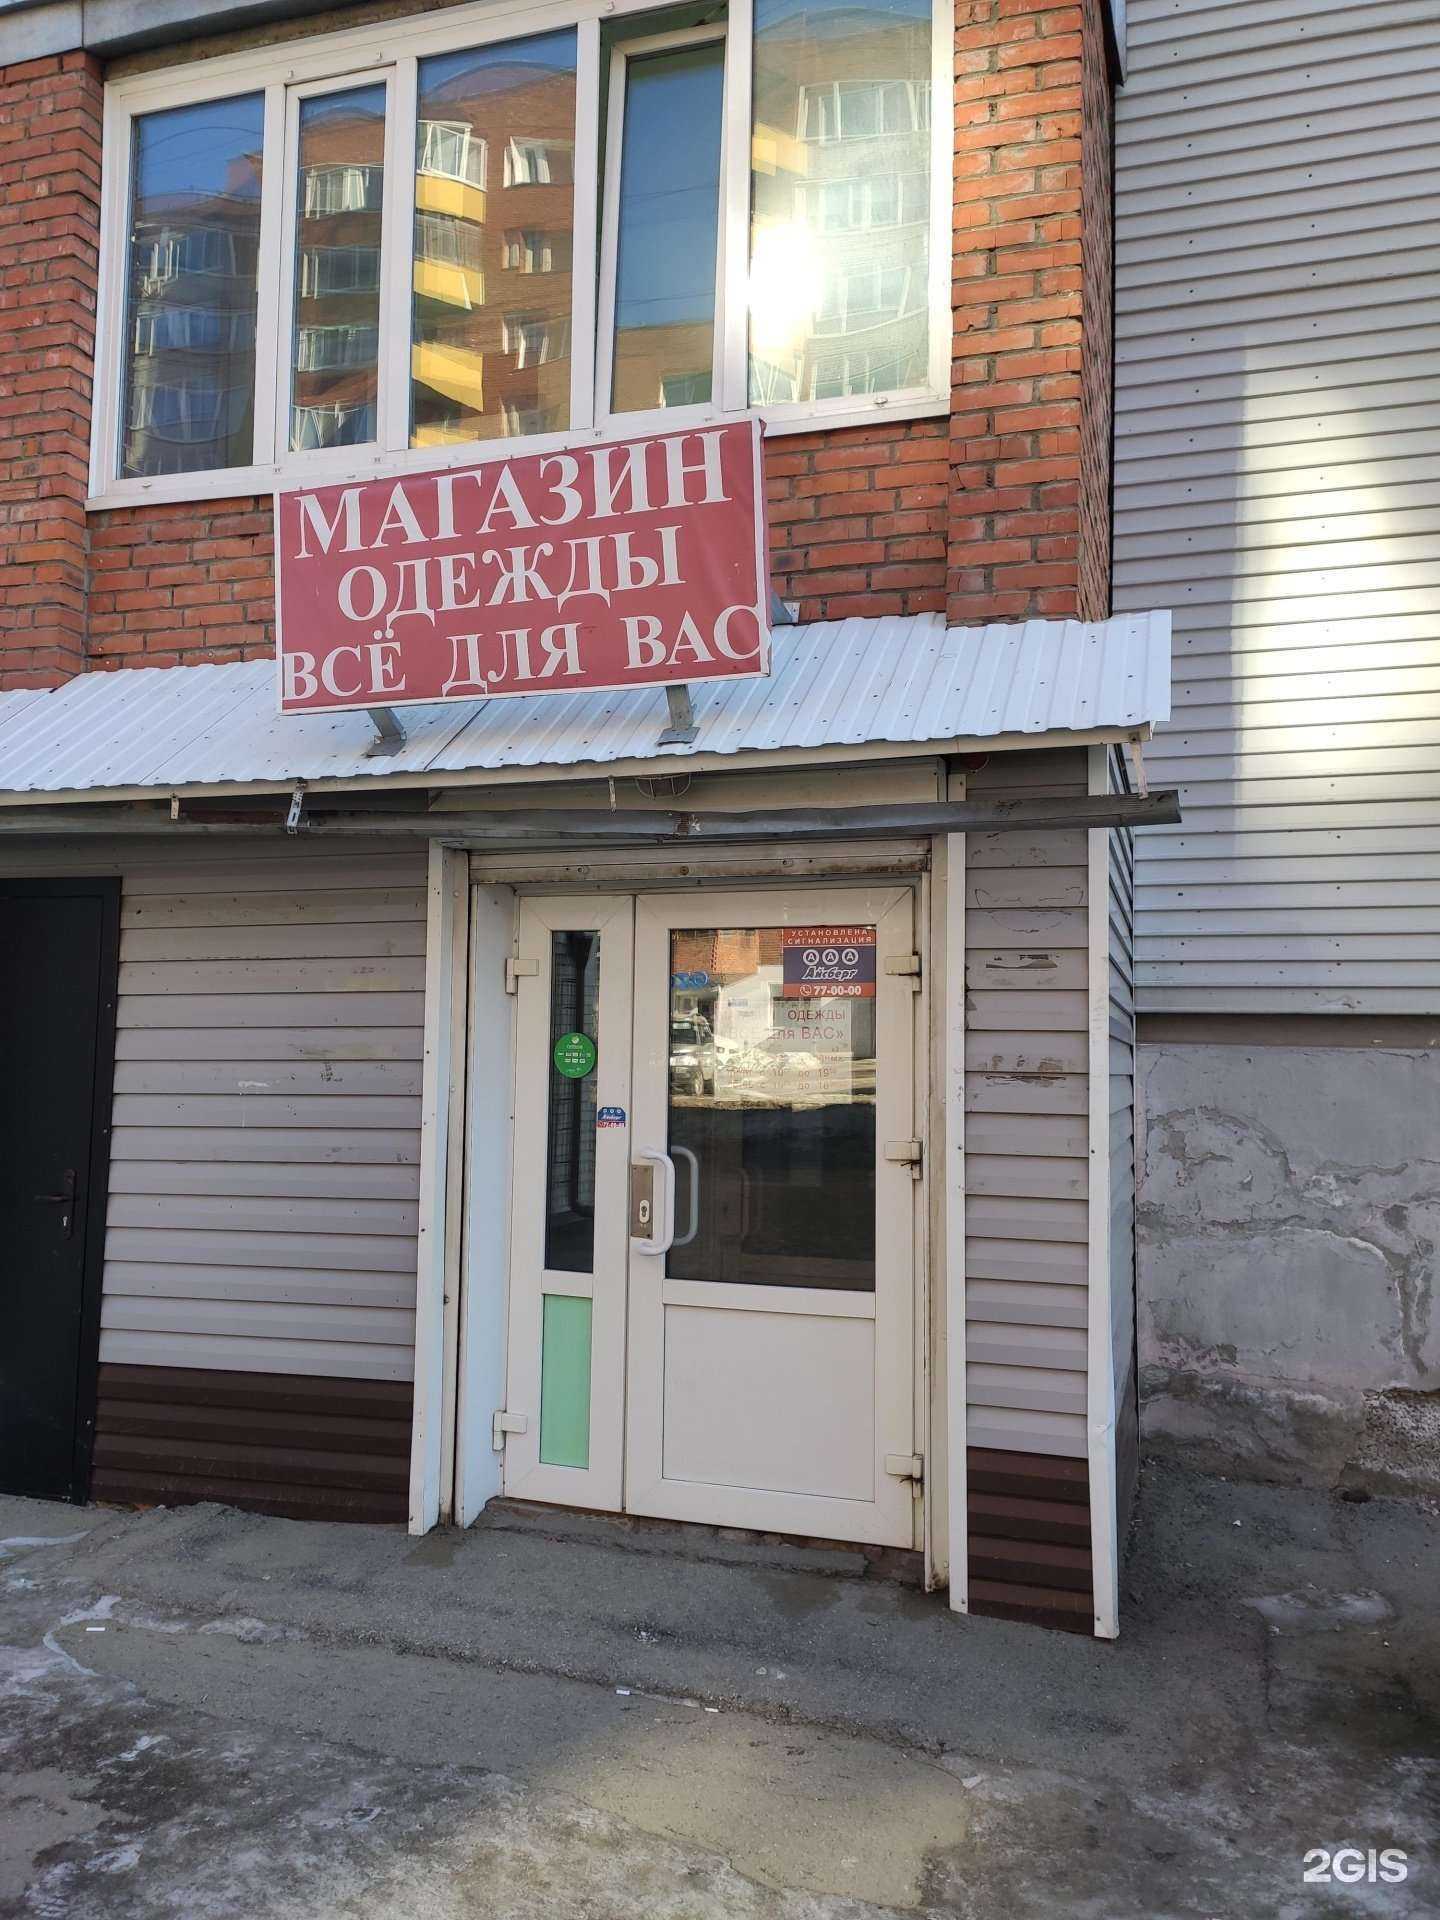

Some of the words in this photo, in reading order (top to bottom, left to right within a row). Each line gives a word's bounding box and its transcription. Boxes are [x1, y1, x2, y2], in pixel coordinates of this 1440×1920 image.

[294, 429, 732, 559] МАГАЗИН
[337, 525, 686, 628] ОДЕЖДЫ
[282, 628, 407, 701] ВСЁ
[441, 622, 587, 697] ДЛЯ
[619, 604, 766, 671] ВАС
[791, 928, 868, 937] УСТАНОВЛЕНА
[787, 937, 872, 945] СИГНАЛИЗАЦИЯ
[801, 965, 858, 981] Айсберг
[814, 986, 862, 995] 77-00-00
[788, 1009, 846, 1022] ОДЕЖДЫ
